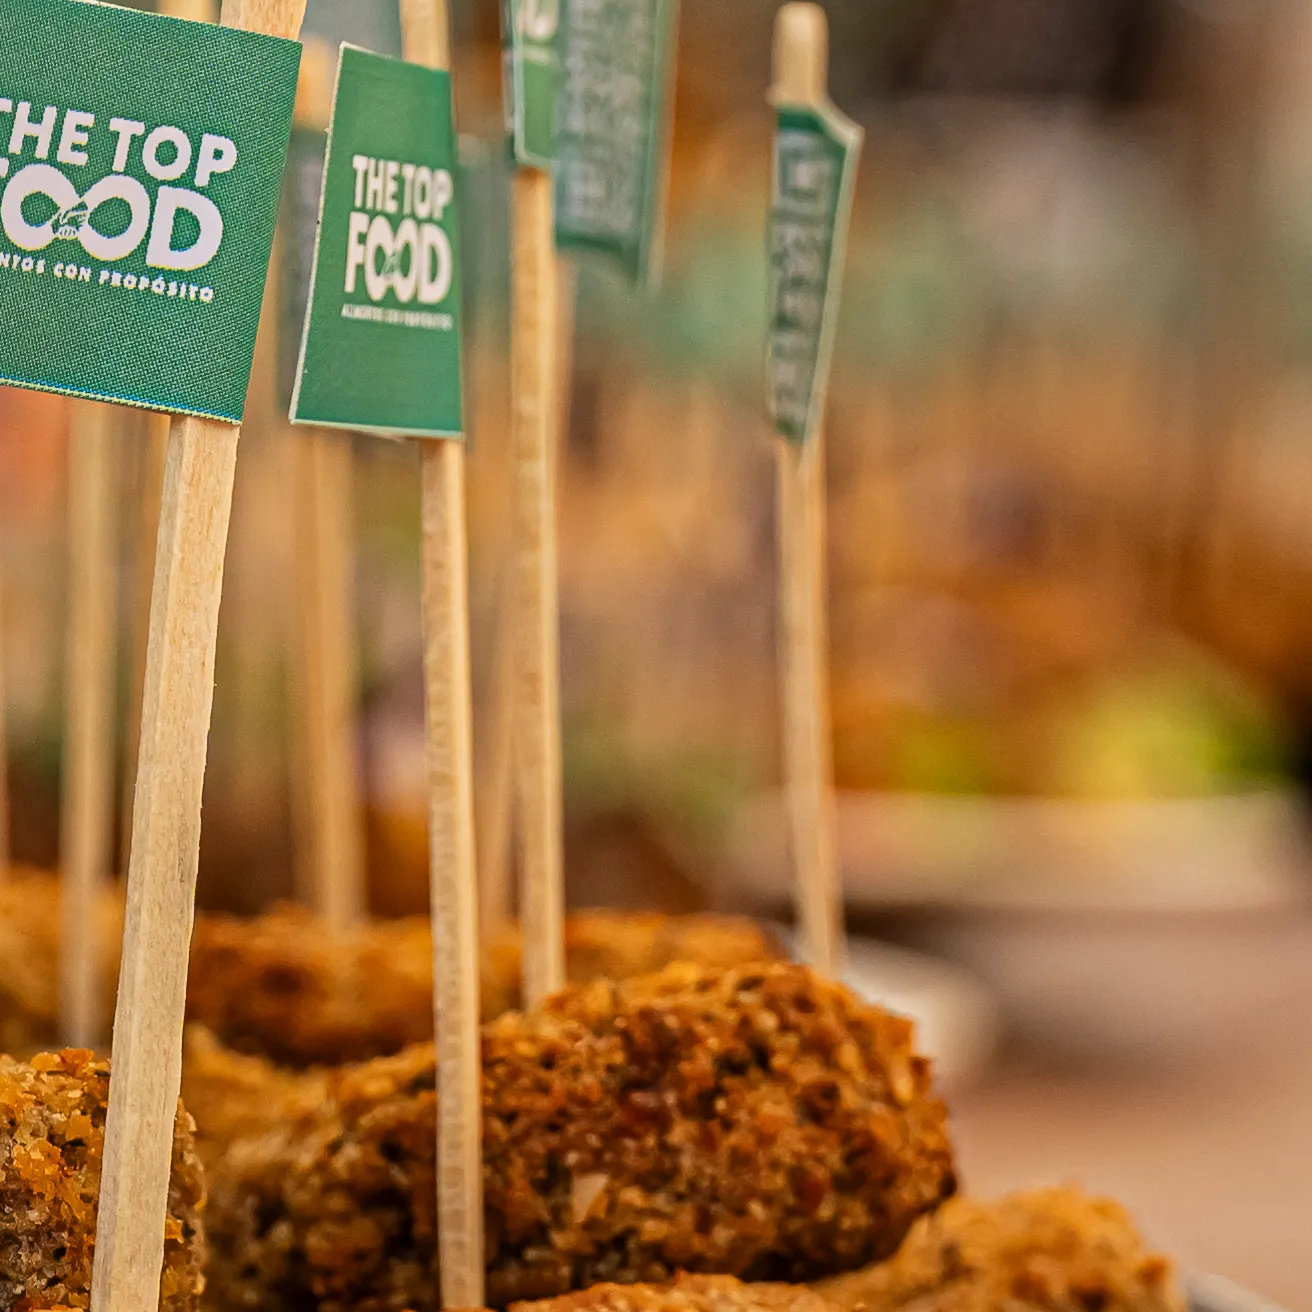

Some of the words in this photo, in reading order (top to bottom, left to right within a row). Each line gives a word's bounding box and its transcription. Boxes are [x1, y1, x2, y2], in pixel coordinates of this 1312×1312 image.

[109, 117, 238, 187] TOP
[352, 154, 400, 214] THE
[401, 163, 454, 220] TOP
[53, 263, 91, 283] CON
[344, 211, 453, 305] FOOD
